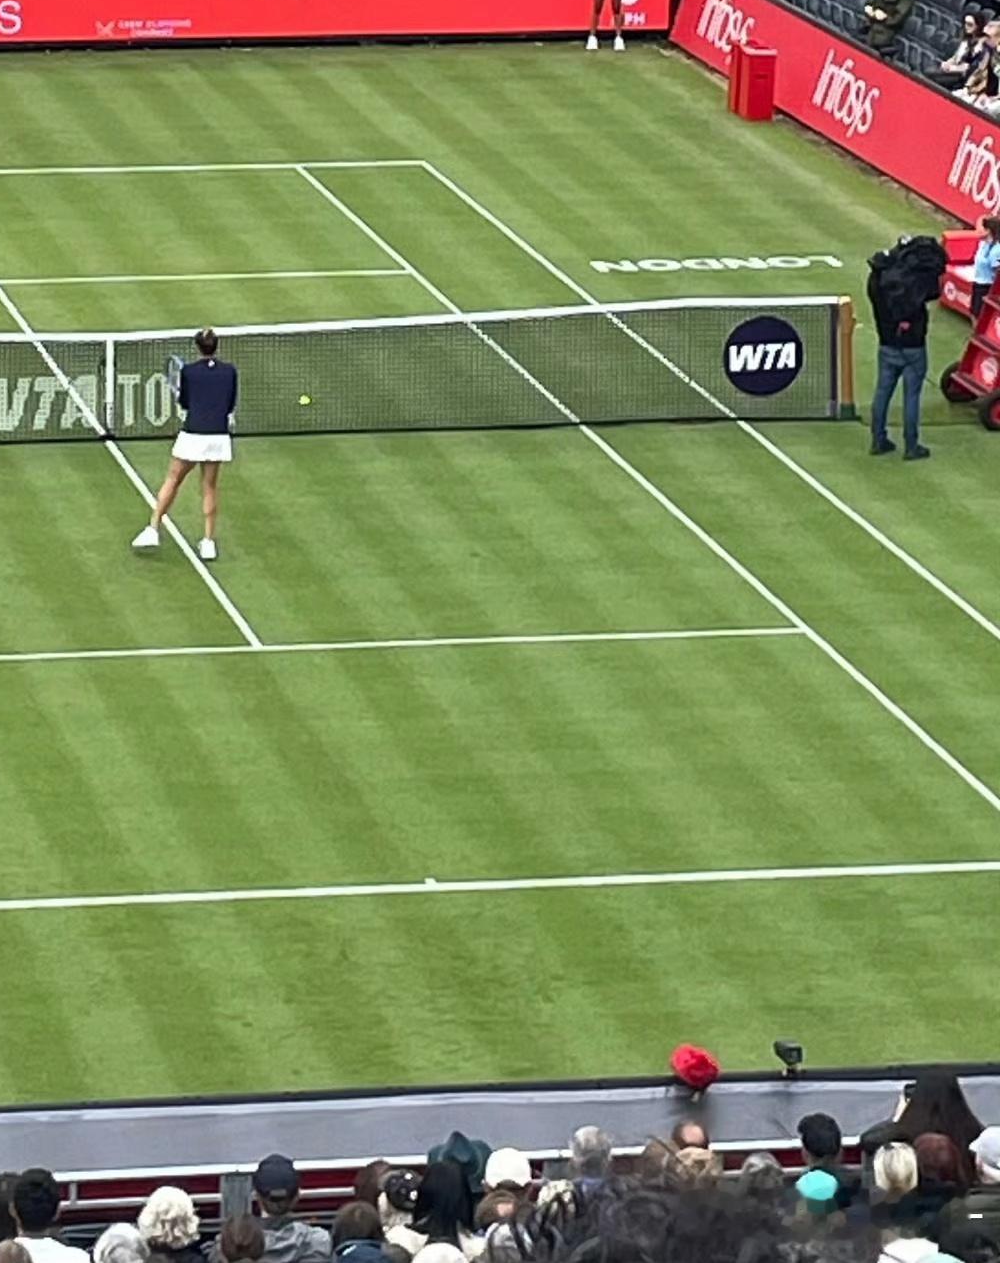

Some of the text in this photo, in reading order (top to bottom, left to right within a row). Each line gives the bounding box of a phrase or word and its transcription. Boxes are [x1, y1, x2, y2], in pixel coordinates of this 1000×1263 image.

[812, 48, 881, 138] Infosys
[588, 254, 844, 273] LONDON
[729, 341, 796, 372] WTA
